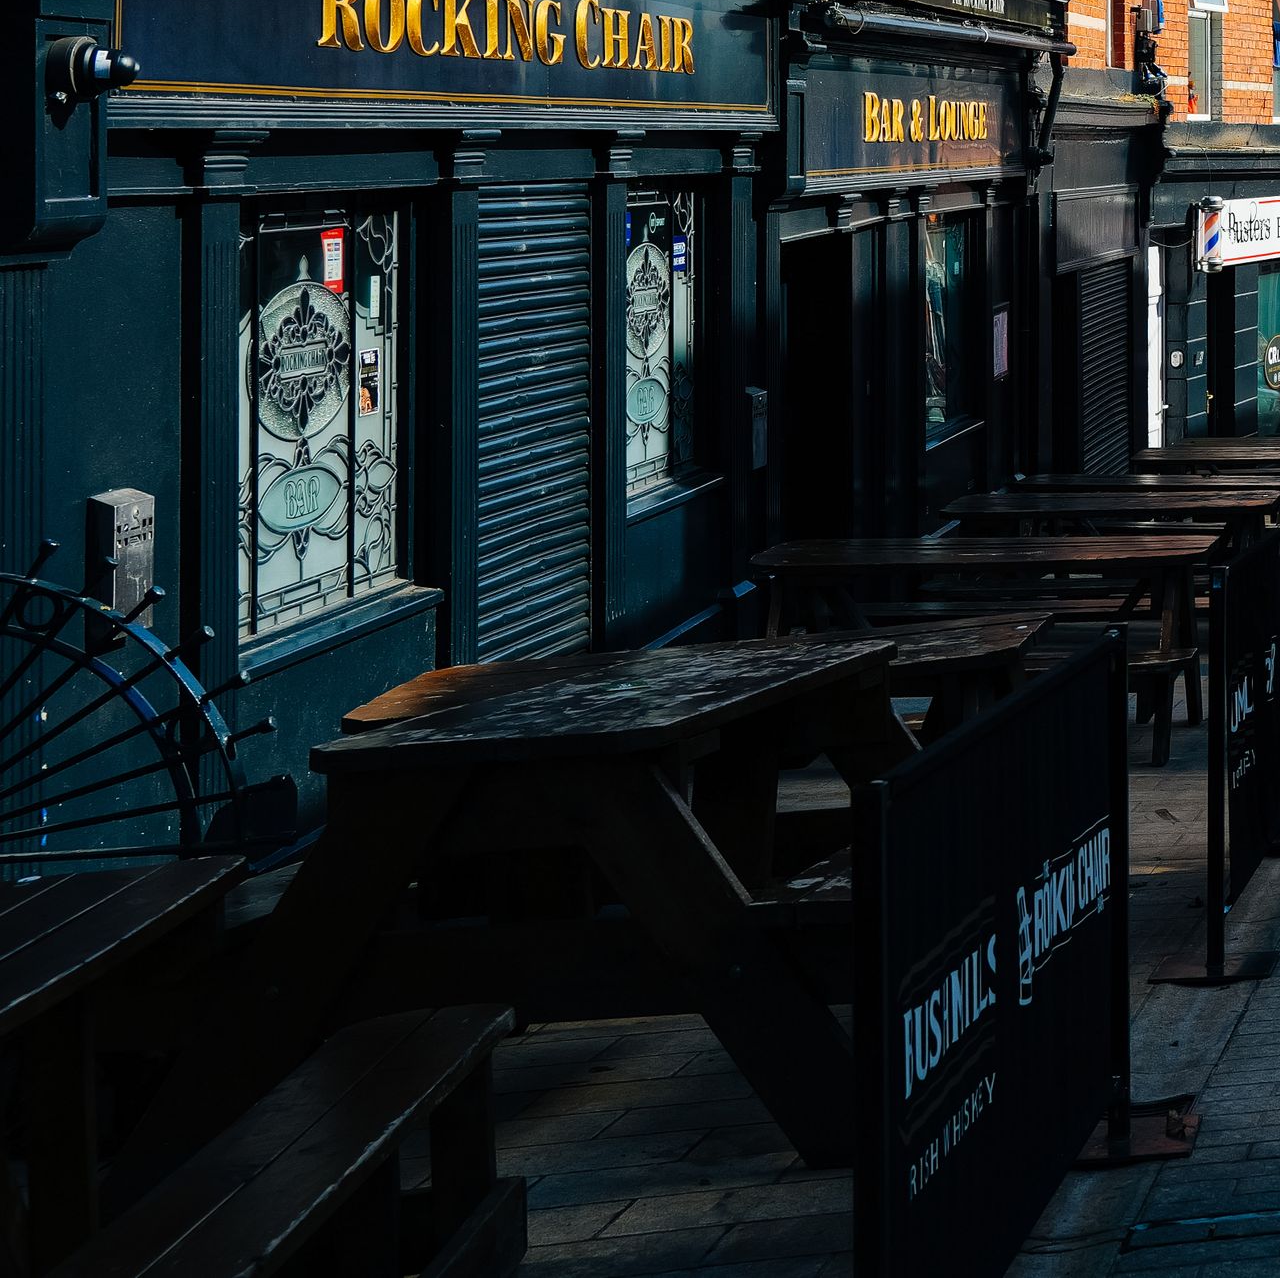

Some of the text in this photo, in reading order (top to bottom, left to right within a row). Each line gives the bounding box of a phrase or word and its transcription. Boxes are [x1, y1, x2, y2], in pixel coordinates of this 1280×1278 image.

[863, 91, 988, 143] BAR & LOUNGE
[284, 475, 321, 518] BAR
[1078, 827, 1111, 910] CHAIR
